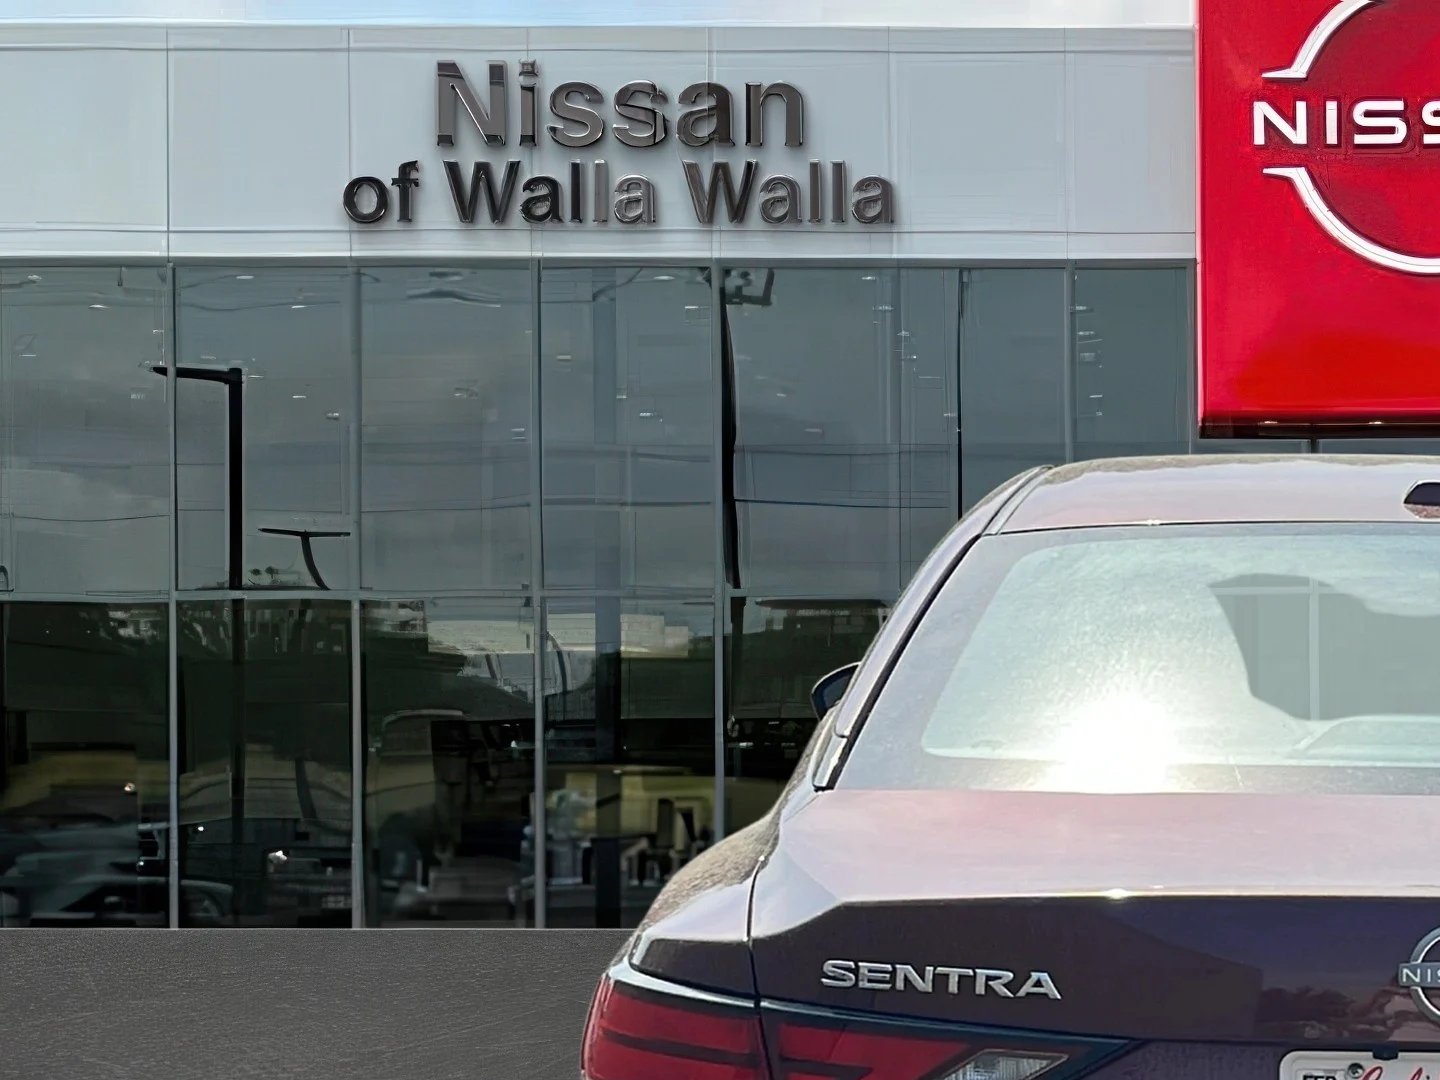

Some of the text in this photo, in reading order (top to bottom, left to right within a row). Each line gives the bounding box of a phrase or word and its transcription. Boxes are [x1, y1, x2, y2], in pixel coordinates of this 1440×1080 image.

[435, 59, 804, 148] Nissan
[341, 158, 896, 225] of Walla Walla
[820, 958, 1063, 1000] SENTRA
